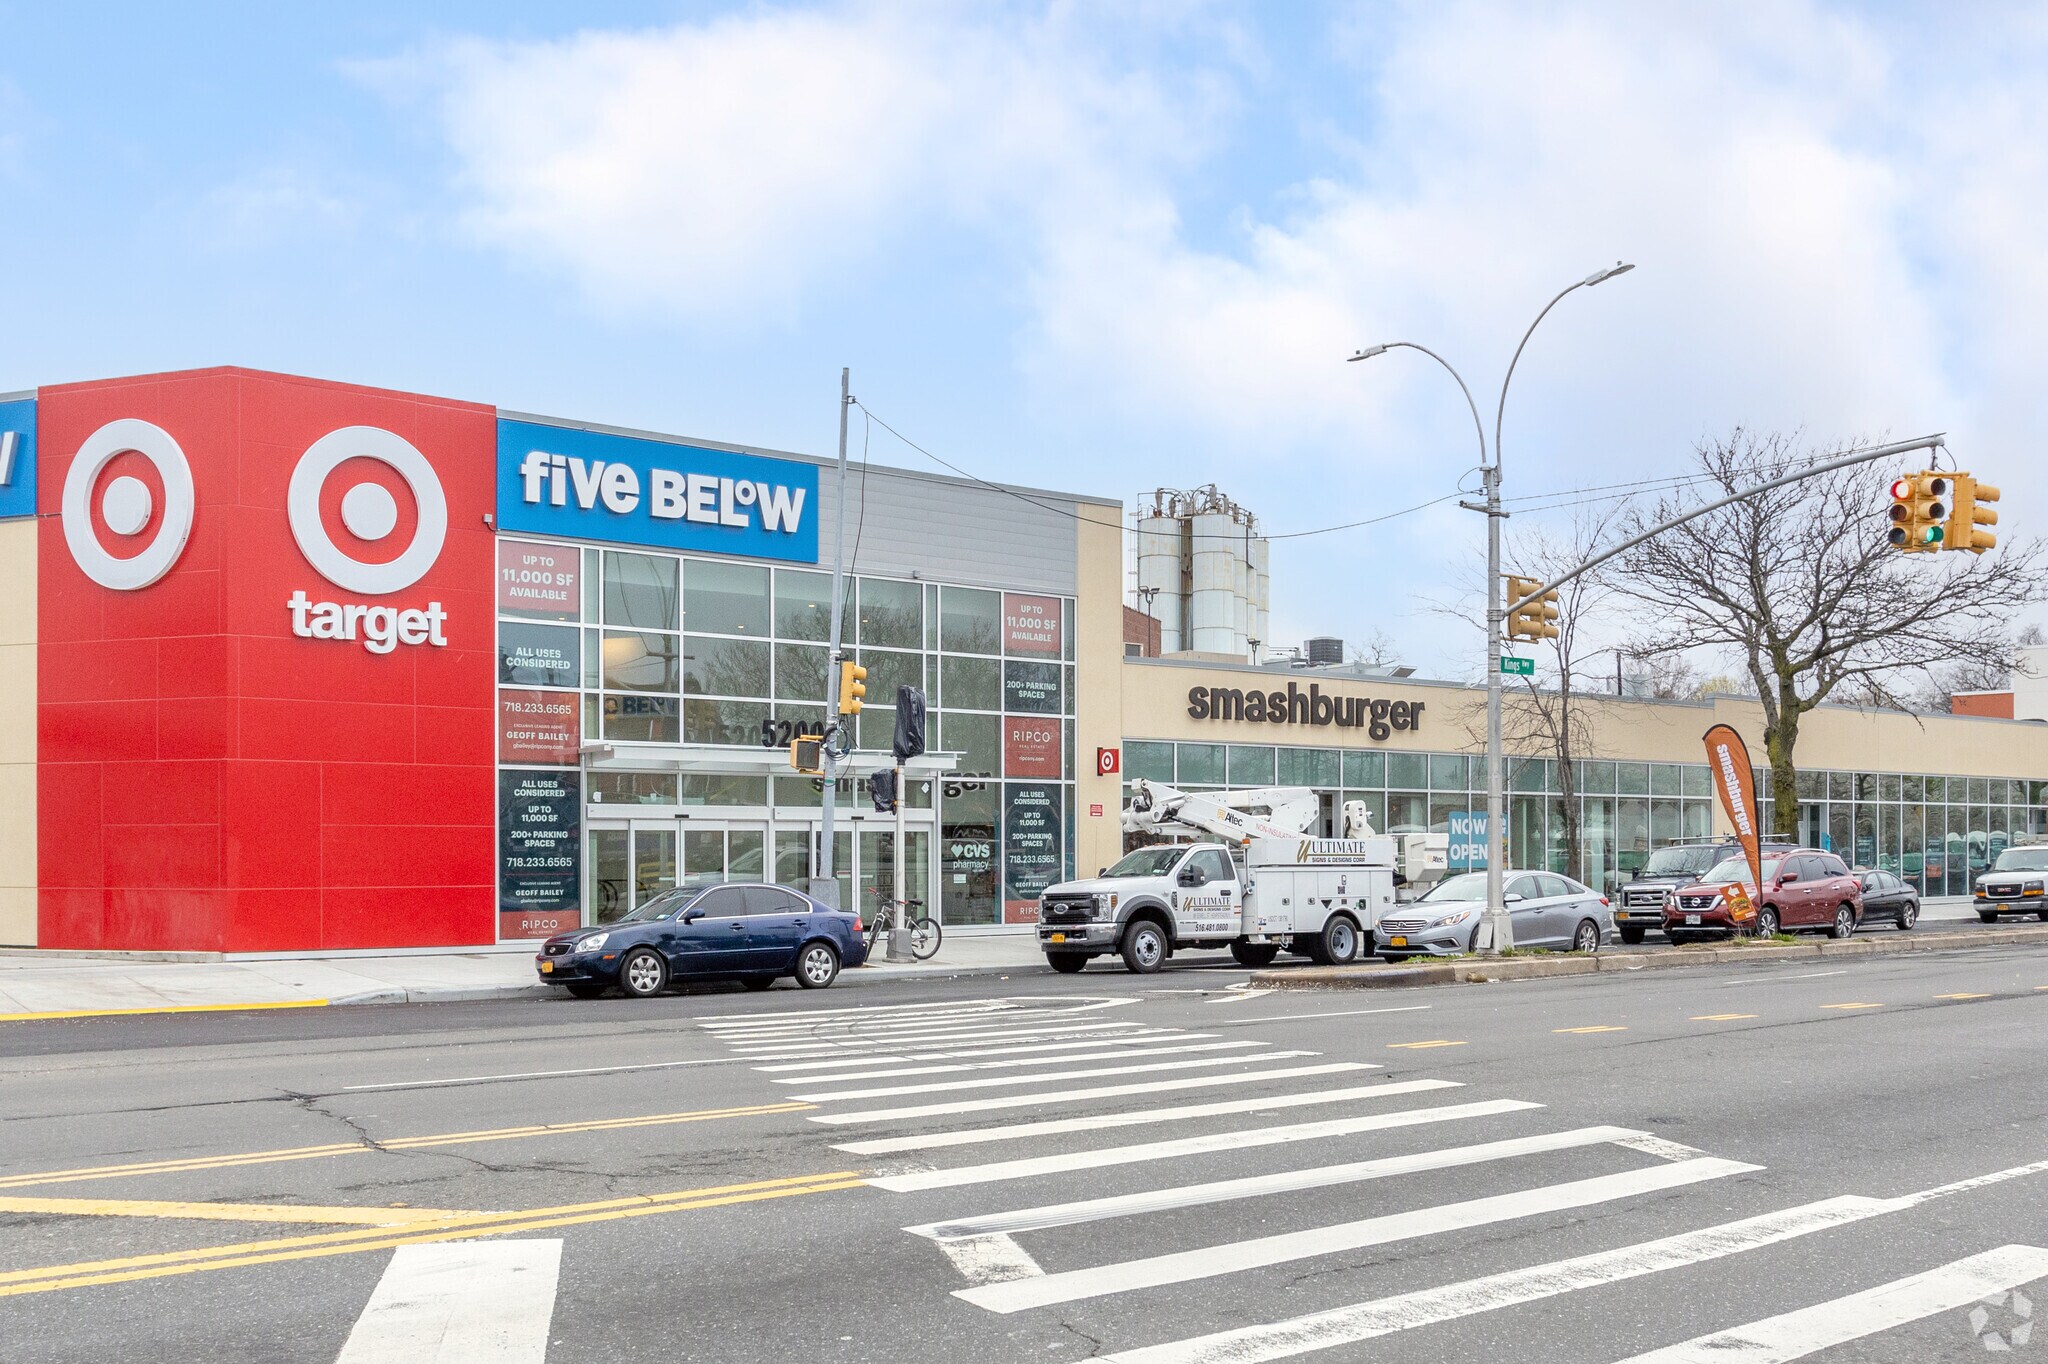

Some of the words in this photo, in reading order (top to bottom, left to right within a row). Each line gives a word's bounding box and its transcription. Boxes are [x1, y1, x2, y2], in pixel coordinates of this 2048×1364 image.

[519, 450, 640, 514] five
[650, 468, 806, 533] BELOW
[523, 555, 538, 565] UP
[540, 556, 554, 567] TO
[502, 568, 552, 584] 11,000
[556, 574, 574, 586] SF
[510, 587, 567, 600] AVAILABLE
[1021, 604, 1032, 613] UP
[1032, 606, 1042, 614] TO
[287, 590, 448, 654] target
[1007, 616, 1042, 629] 11,000
[1044, 620, 1056, 630] SF
[1012, 631, 1052, 642] AVAILABLE
[516, 647, 535, 656] ALL
[536, 648, 562, 658] USES
[506, 657, 570, 670] CONSIDERED
[1504, 658, 1520, 674] Kings
[1006, 680, 1024, 689] 200+
[1026, 682, 1056, 690] PARKING
[1018, 690, 1045, 698] SPACES
[504, 702, 572, 714] 718.233.6565
[1188, 682, 1425, 740] smashburger
[506, 731, 536, 740] GEOFF
[538, 732, 570, 740] BAILEY
[1014, 730, 1050, 742] RIPCO
[514, 789, 566, 797] CONSIDERED
[1716, 744, 1752, 836] smashburger
[1225, 812, 1244, 827] Altec
[1452, 818, 1487, 834] NOW
[964, 844, 990, 858] CVS
[1312, 841, 1366, 853] ULTIMATE
[1450, 844, 1488, 860] OPEN
[506, 858, 572, 867] 718.233.6565
[953, 860, 988, 870] pharmacy
[1010, 855, 1054, 864] 718.233.6565
[1194, 897, 1230, 906] ULTIMATE
[1020, 906, 1038, 914] RIPC
[522, 920, 558, 929] RIPCO
